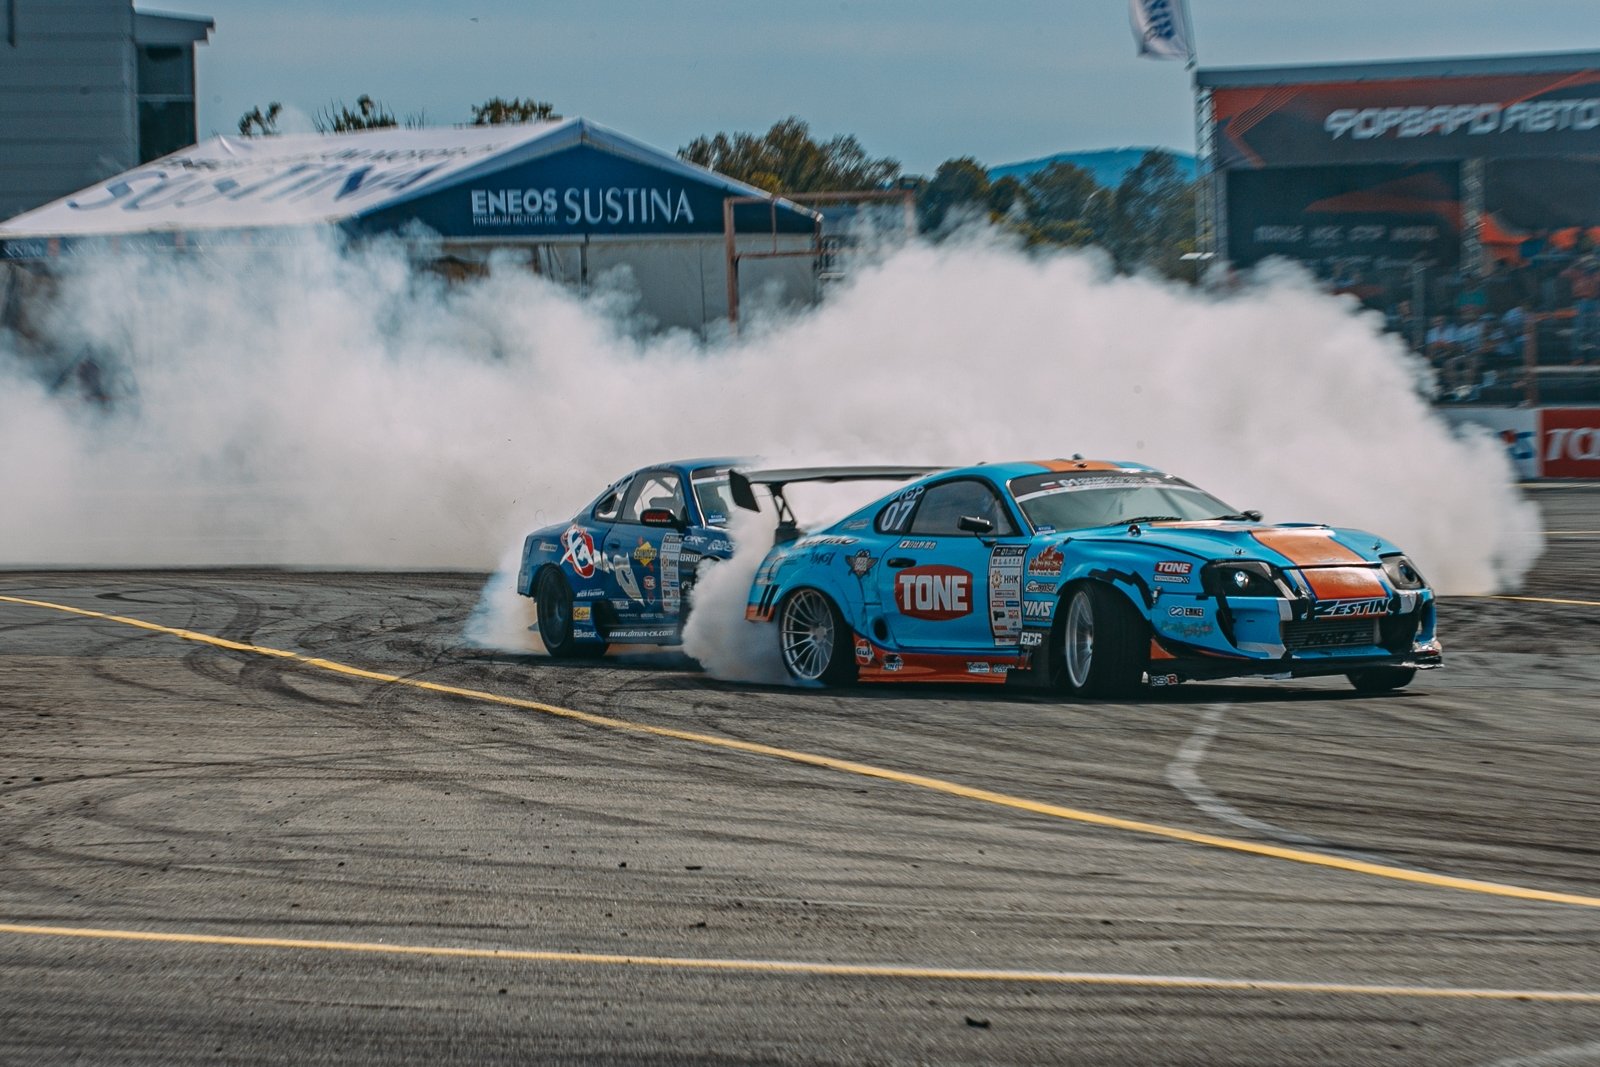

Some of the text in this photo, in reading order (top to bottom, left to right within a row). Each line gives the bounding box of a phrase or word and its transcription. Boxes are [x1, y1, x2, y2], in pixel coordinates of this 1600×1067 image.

[471, 187, 695, 225] ENEOS SUSTINA
[473, 214, 556, 226] PREMIUM MOTOR OIL
[881, 500, 916, 531] 07
[680, 554, 701, 563] BRID
[1158, 562, 1191, 573] TONE
[1003, 575, 1019, 585] HHK
[900, 574, 968, 612] TONE
[1020, 632, 1042, 646] GCG
